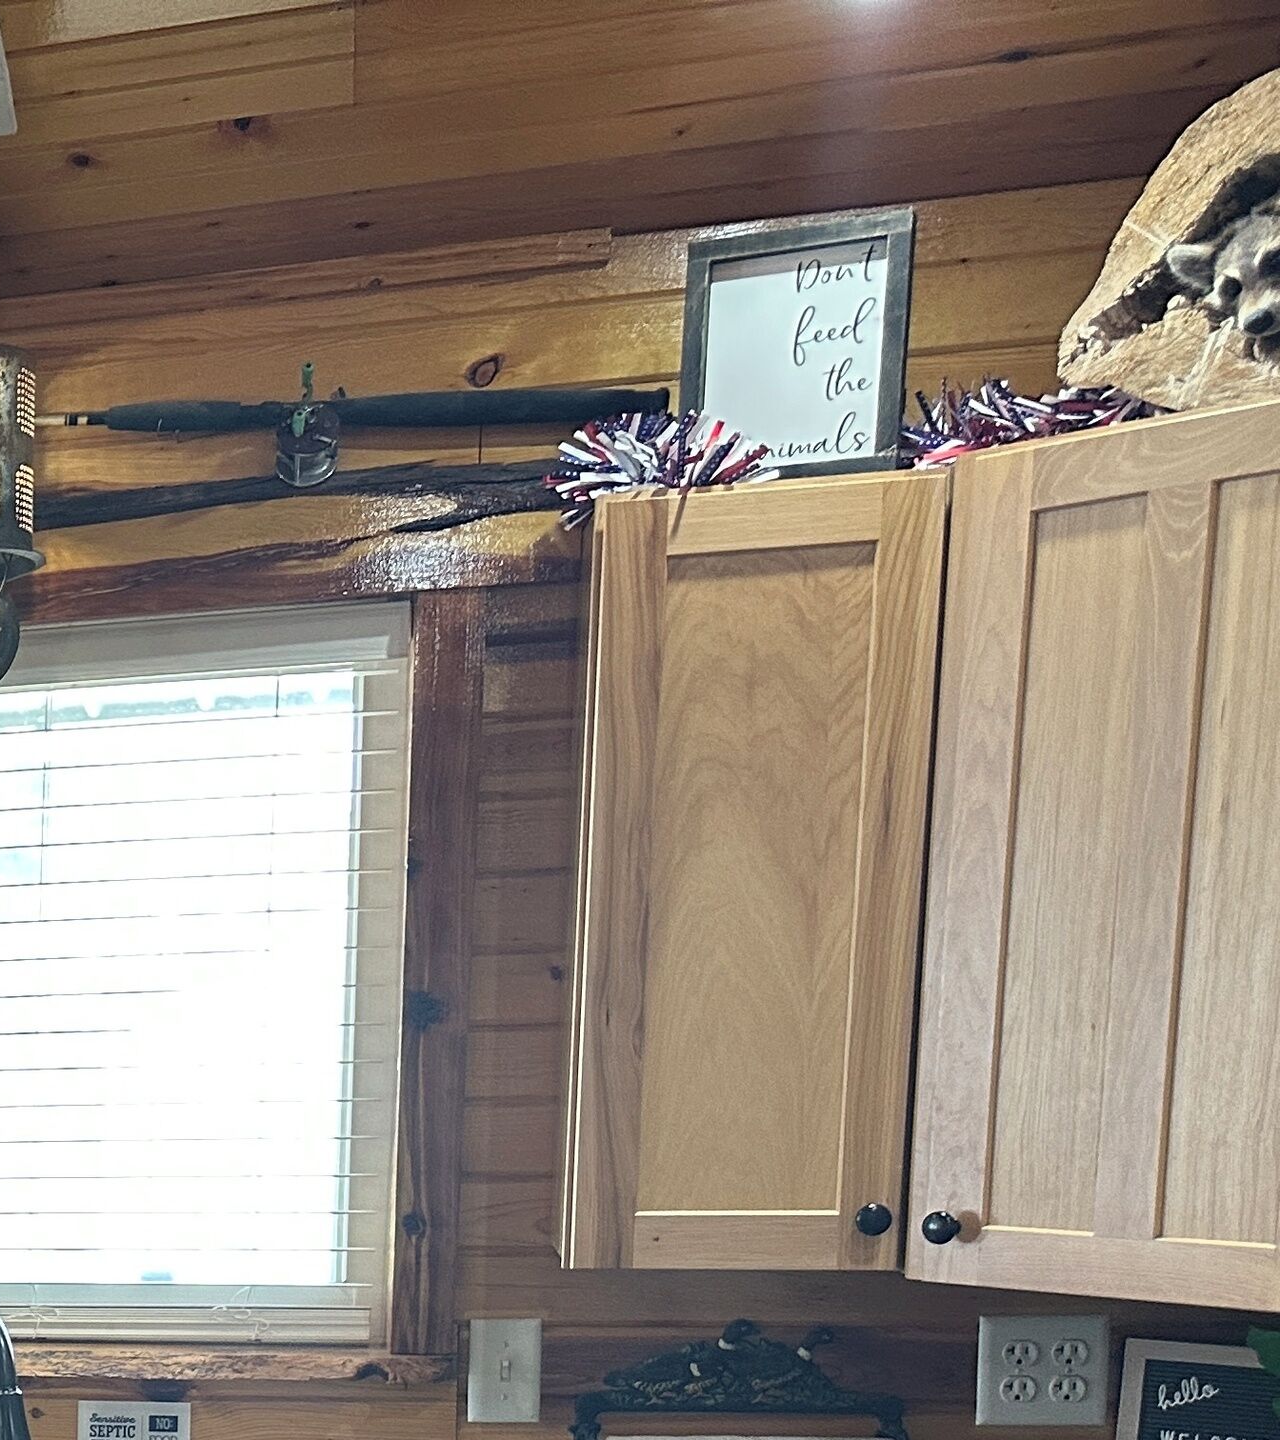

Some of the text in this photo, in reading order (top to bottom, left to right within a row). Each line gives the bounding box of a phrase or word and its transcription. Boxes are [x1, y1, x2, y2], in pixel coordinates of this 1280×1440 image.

[793, 297, 877, 366] feed
[823, 357, 873, 401] the
[1157, 1376, 1220, 1411] hello
[89, 1424, 136, 1438] SEPTIC
